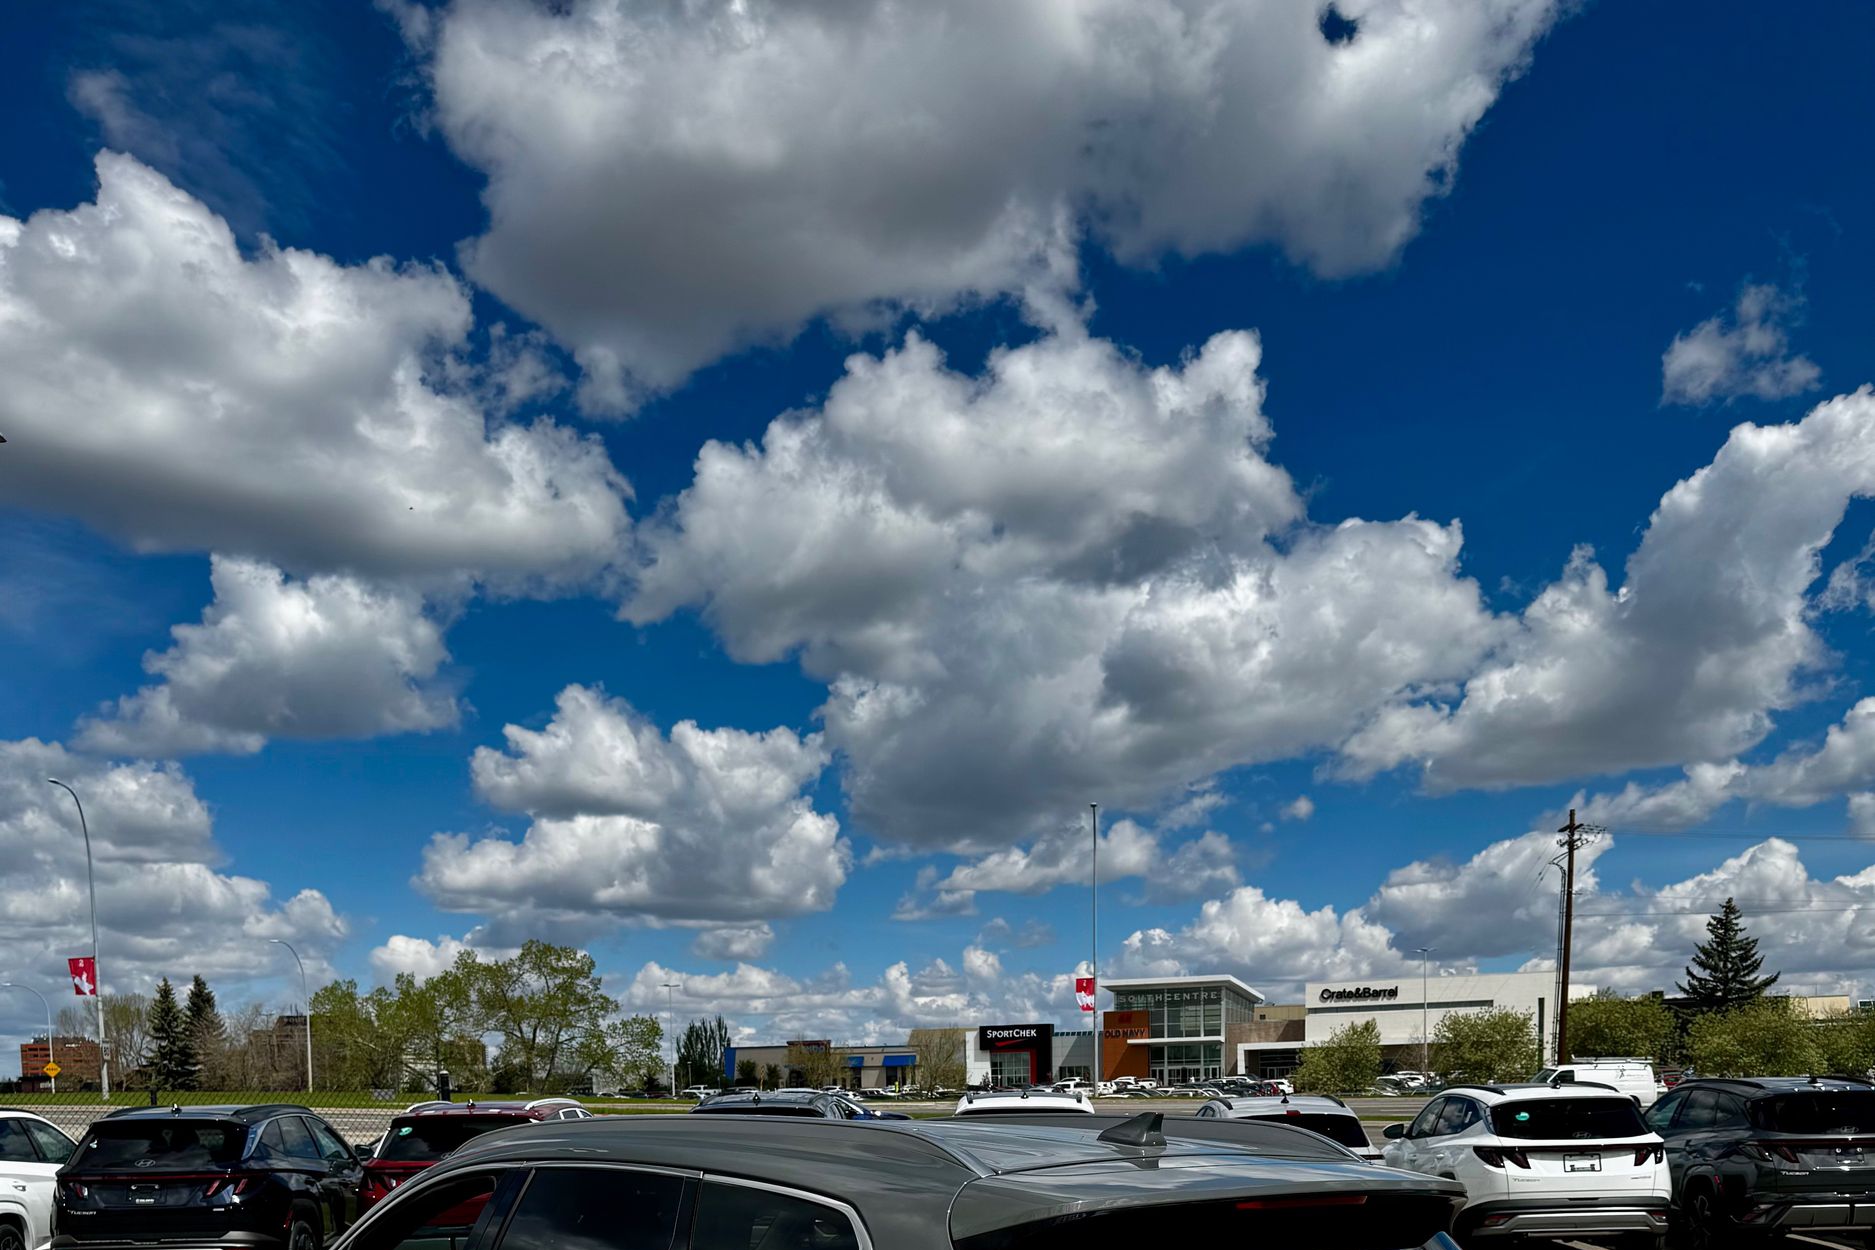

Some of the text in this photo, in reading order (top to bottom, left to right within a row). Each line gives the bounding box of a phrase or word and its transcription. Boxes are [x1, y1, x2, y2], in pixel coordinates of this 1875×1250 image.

[1119, 991, 1217, 1003] SOUTHCENTRE
[1321, 986, 1398, 1000] Crate&Barrel
[986, 1028, 1037, 1038] SPORTCHEK
[1104, 1029, 1122, 1038] OLD
